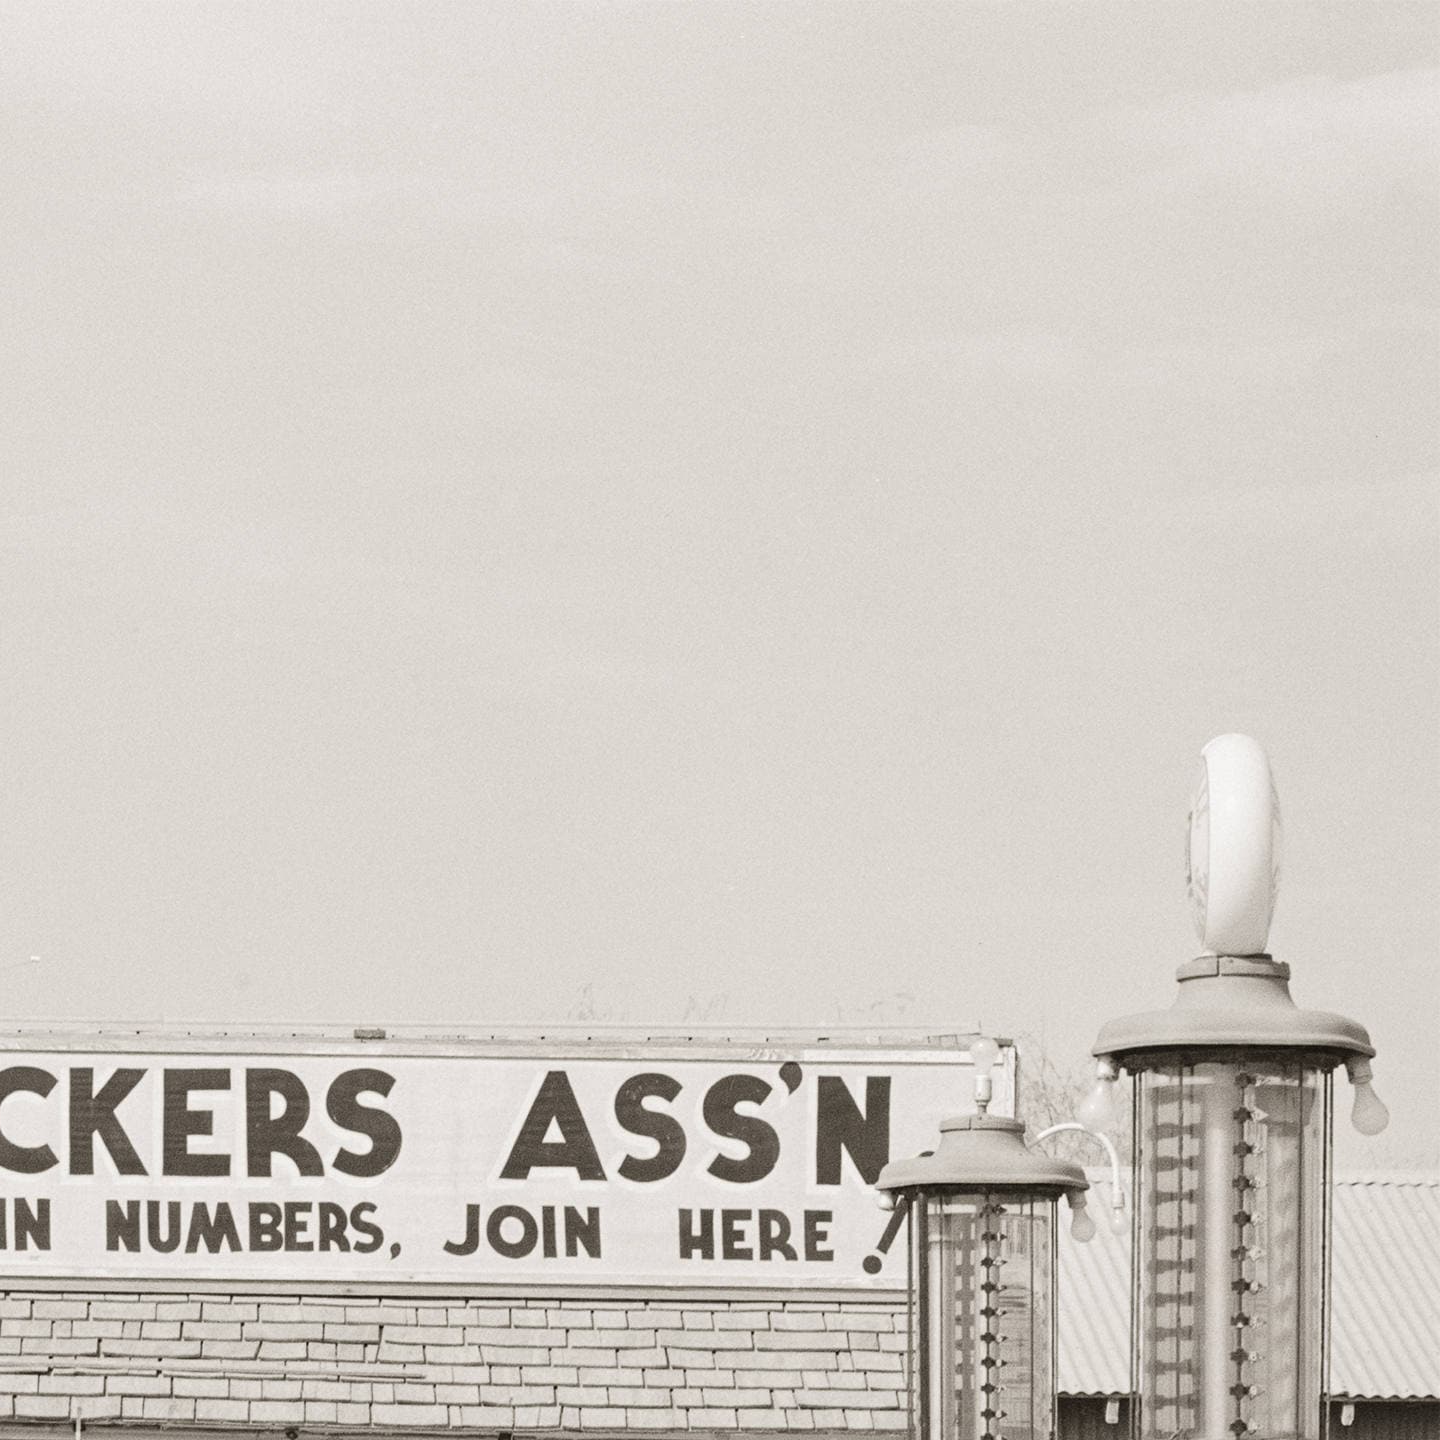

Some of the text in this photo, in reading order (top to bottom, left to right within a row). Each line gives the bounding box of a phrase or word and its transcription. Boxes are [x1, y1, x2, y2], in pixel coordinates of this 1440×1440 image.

[498, 1060, 892, 1187] ASS'N
[105, 1199, 402, 1260] NUMBERS,
[443, 1203, 602, 1260] JOIN
